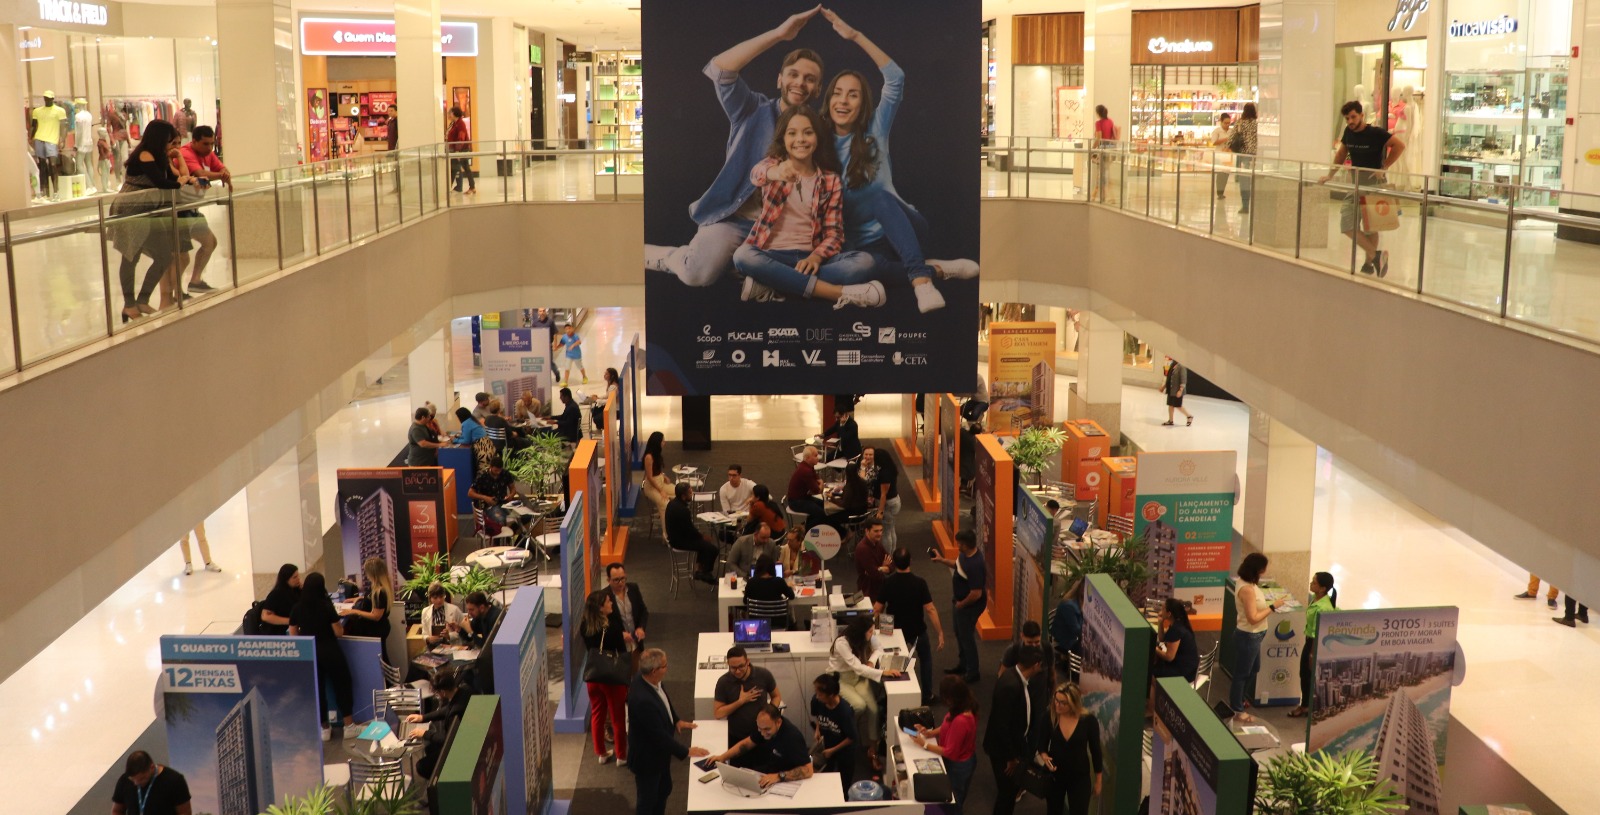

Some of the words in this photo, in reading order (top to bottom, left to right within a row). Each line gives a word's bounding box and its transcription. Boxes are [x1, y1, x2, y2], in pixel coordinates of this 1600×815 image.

[344, 32, 375, 43] Quem
[1165, 39, 1213, 53] natura
[904, 357, 928, 365] CETA
[1179, 500, 1230, 508] LANÇAMENTO
[416, 504, 430, 524] 3
[1185, 531, 1197, 540] 02
[1382, 619, 1390, 630] 3
[1391, 619, 1421, 630] QTOS
[1433, 619, 1456, 628] SUÍTES
[1328, 624, 1376, 636] Benvinda
[173, 644, 179, 652] 1
[180, 644, 228, 653] QUARTO
[238, 641, 296, 649] AGAMENOM
[238, 648, 300, 658] MAGALHÃES
[1266, 646, 1299, 658] CETA
[165, 668, 194, 687] 12
[195, 678, 236, 688] FIXAS
